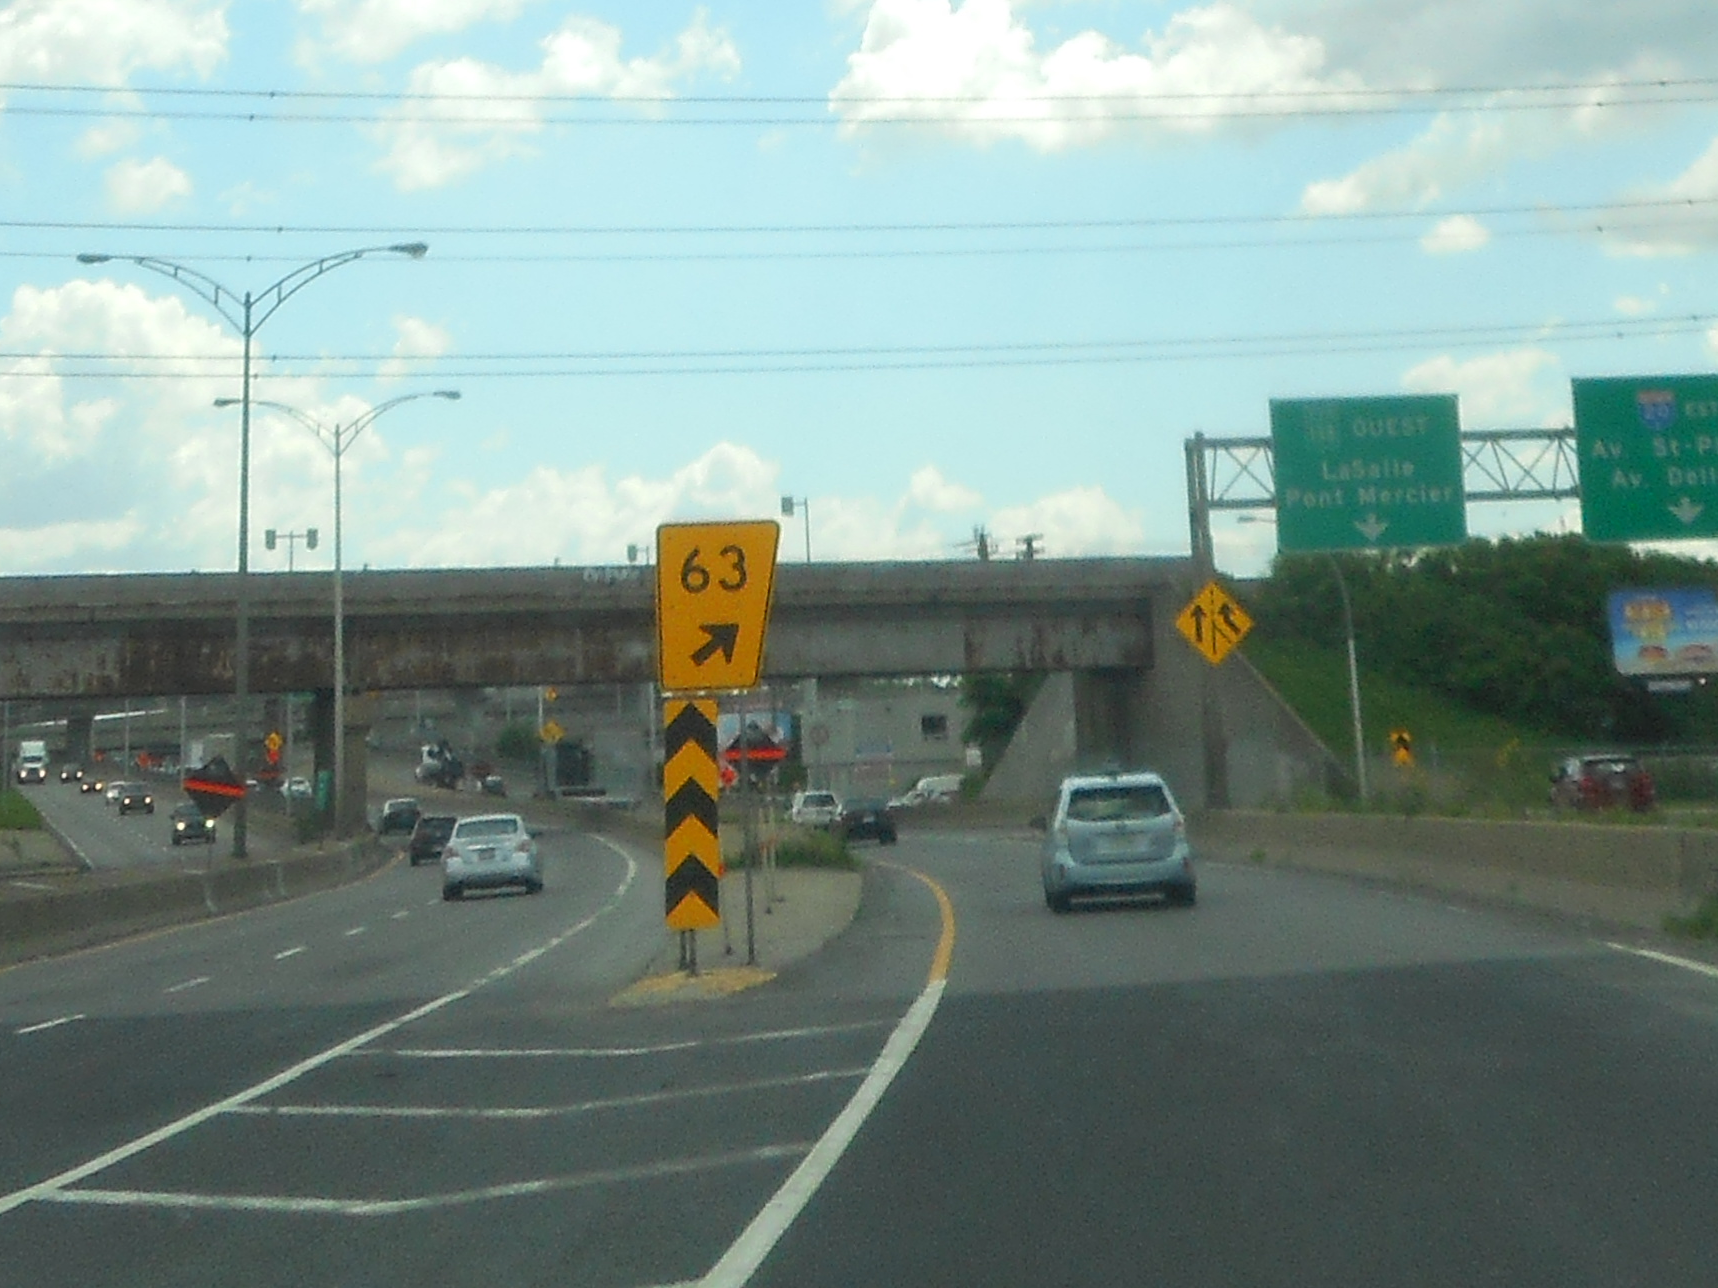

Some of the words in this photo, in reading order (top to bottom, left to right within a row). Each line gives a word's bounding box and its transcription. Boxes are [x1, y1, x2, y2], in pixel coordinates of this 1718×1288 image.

[1684, 400, 1718, 418] EST
[1353, 415, 1429, 437] OUEST
[1321, 458, 1415, 480] LaSalle
[1285, 486, 1344, 508] Pont
[1358, 483, 1454, 505] Mercier
[681, 545, 748, 593] 63
